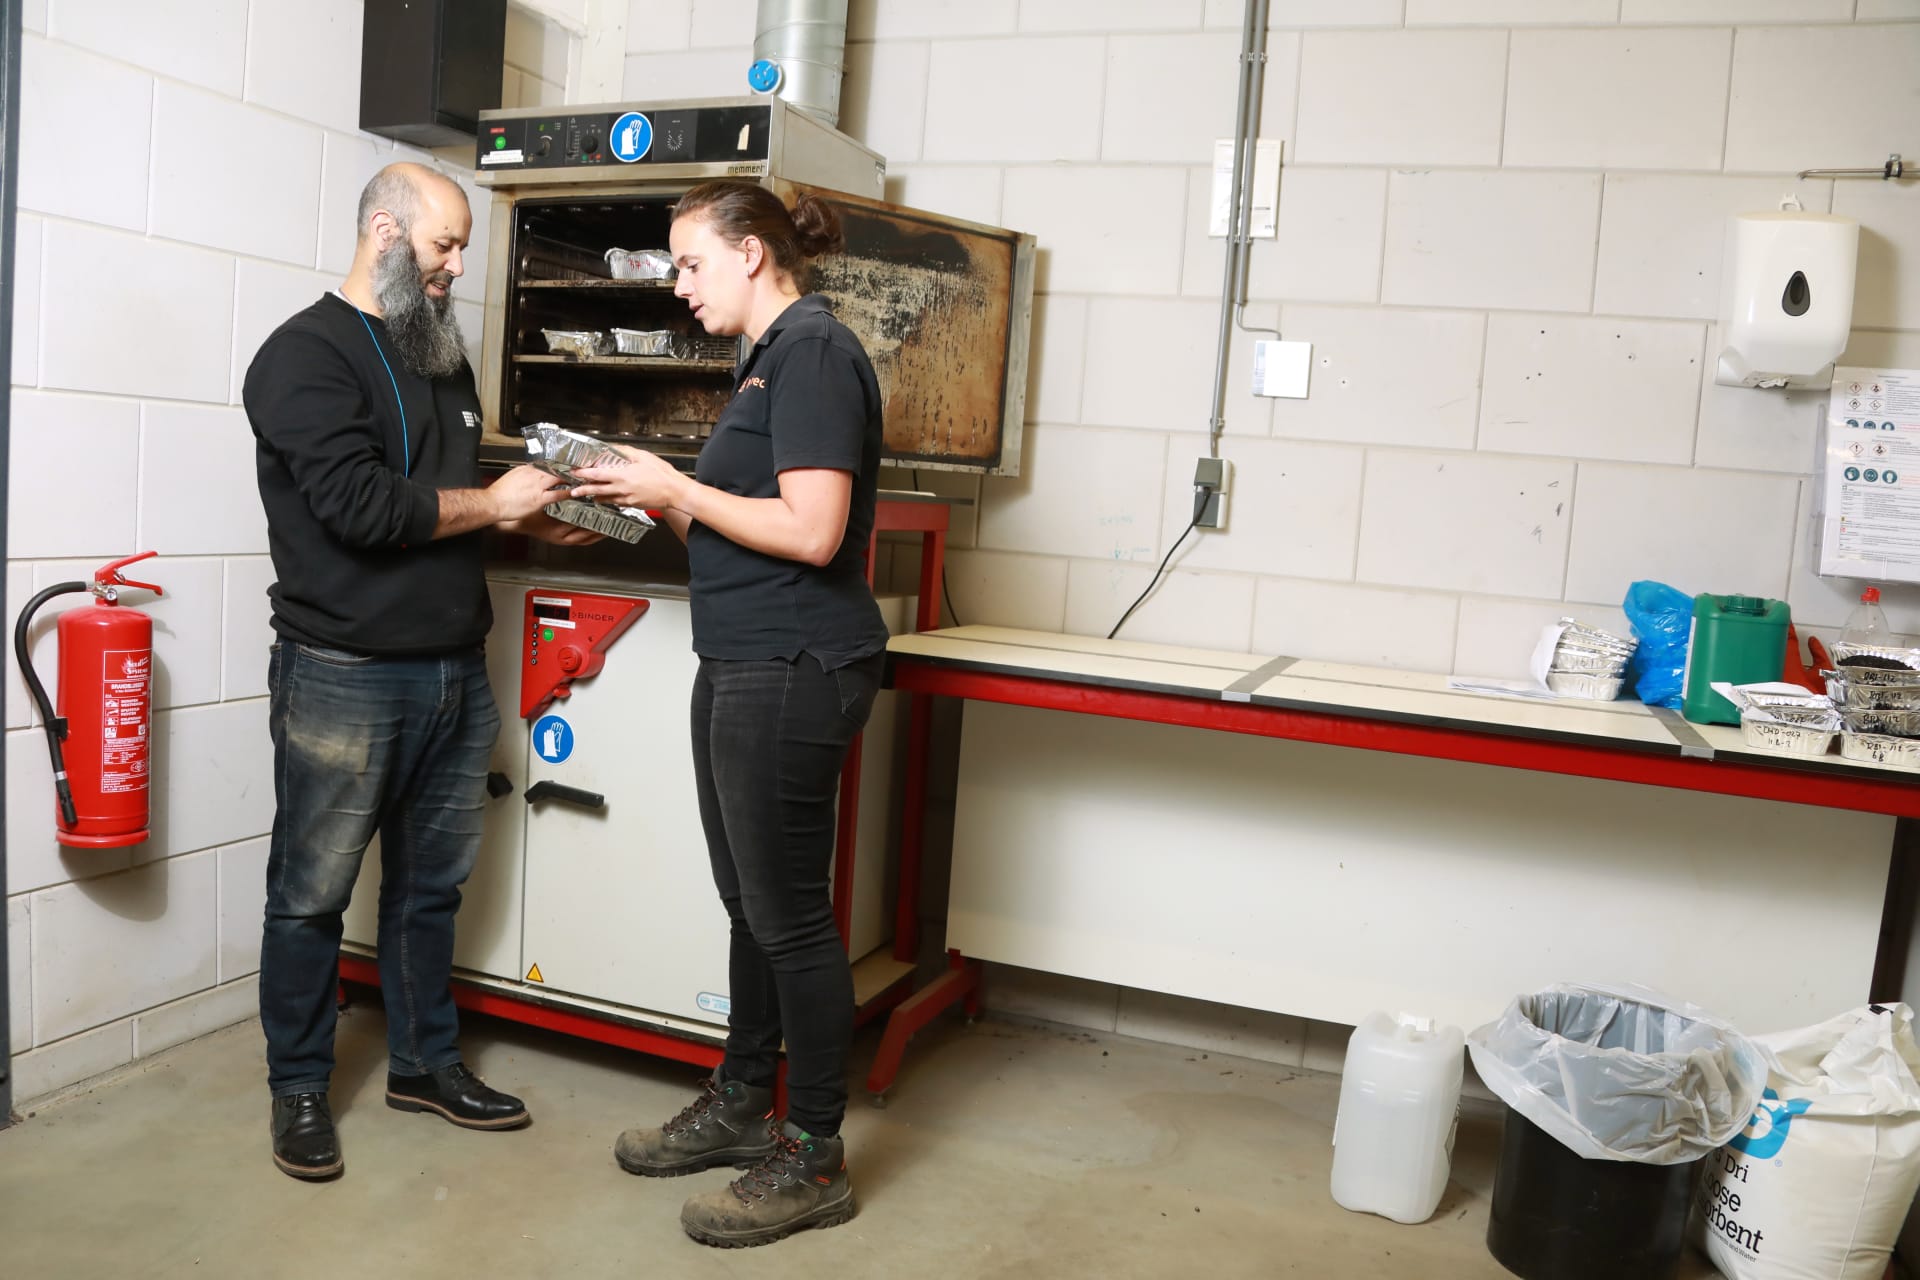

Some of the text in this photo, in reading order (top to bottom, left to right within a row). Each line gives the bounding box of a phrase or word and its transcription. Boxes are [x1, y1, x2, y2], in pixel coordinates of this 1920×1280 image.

[728, 164, 765, 174] memmert
[578, 611, 615, 622] BINDER
[1724, 1153, 1749, 1183] Dri
[1704, 1173, 1741, 1212] oose
[1700, 1196, 1764, 1254] orbent
[1738, 1248, 1757, 1263] Water
